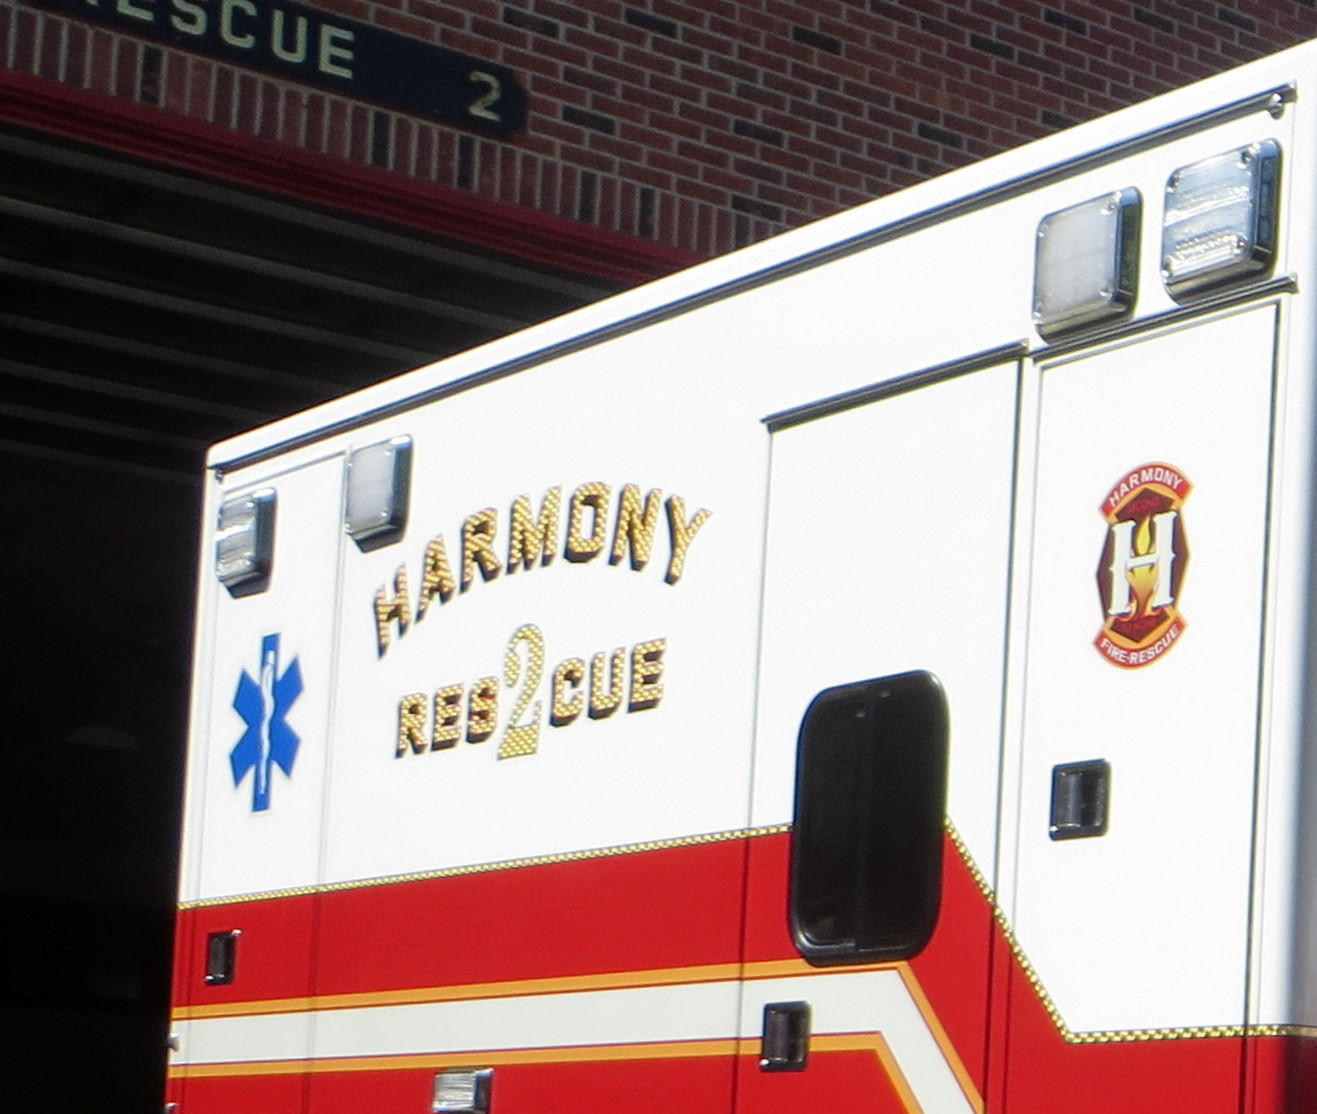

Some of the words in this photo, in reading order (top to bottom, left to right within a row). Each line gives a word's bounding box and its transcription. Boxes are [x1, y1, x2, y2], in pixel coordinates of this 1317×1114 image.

[85, 0, 354, 79] SCUE
[468, 71, 502, 122] 2
[1109, 467, 1182, 507] HARMONY
[373, 481, 712, 660] HARMONY
